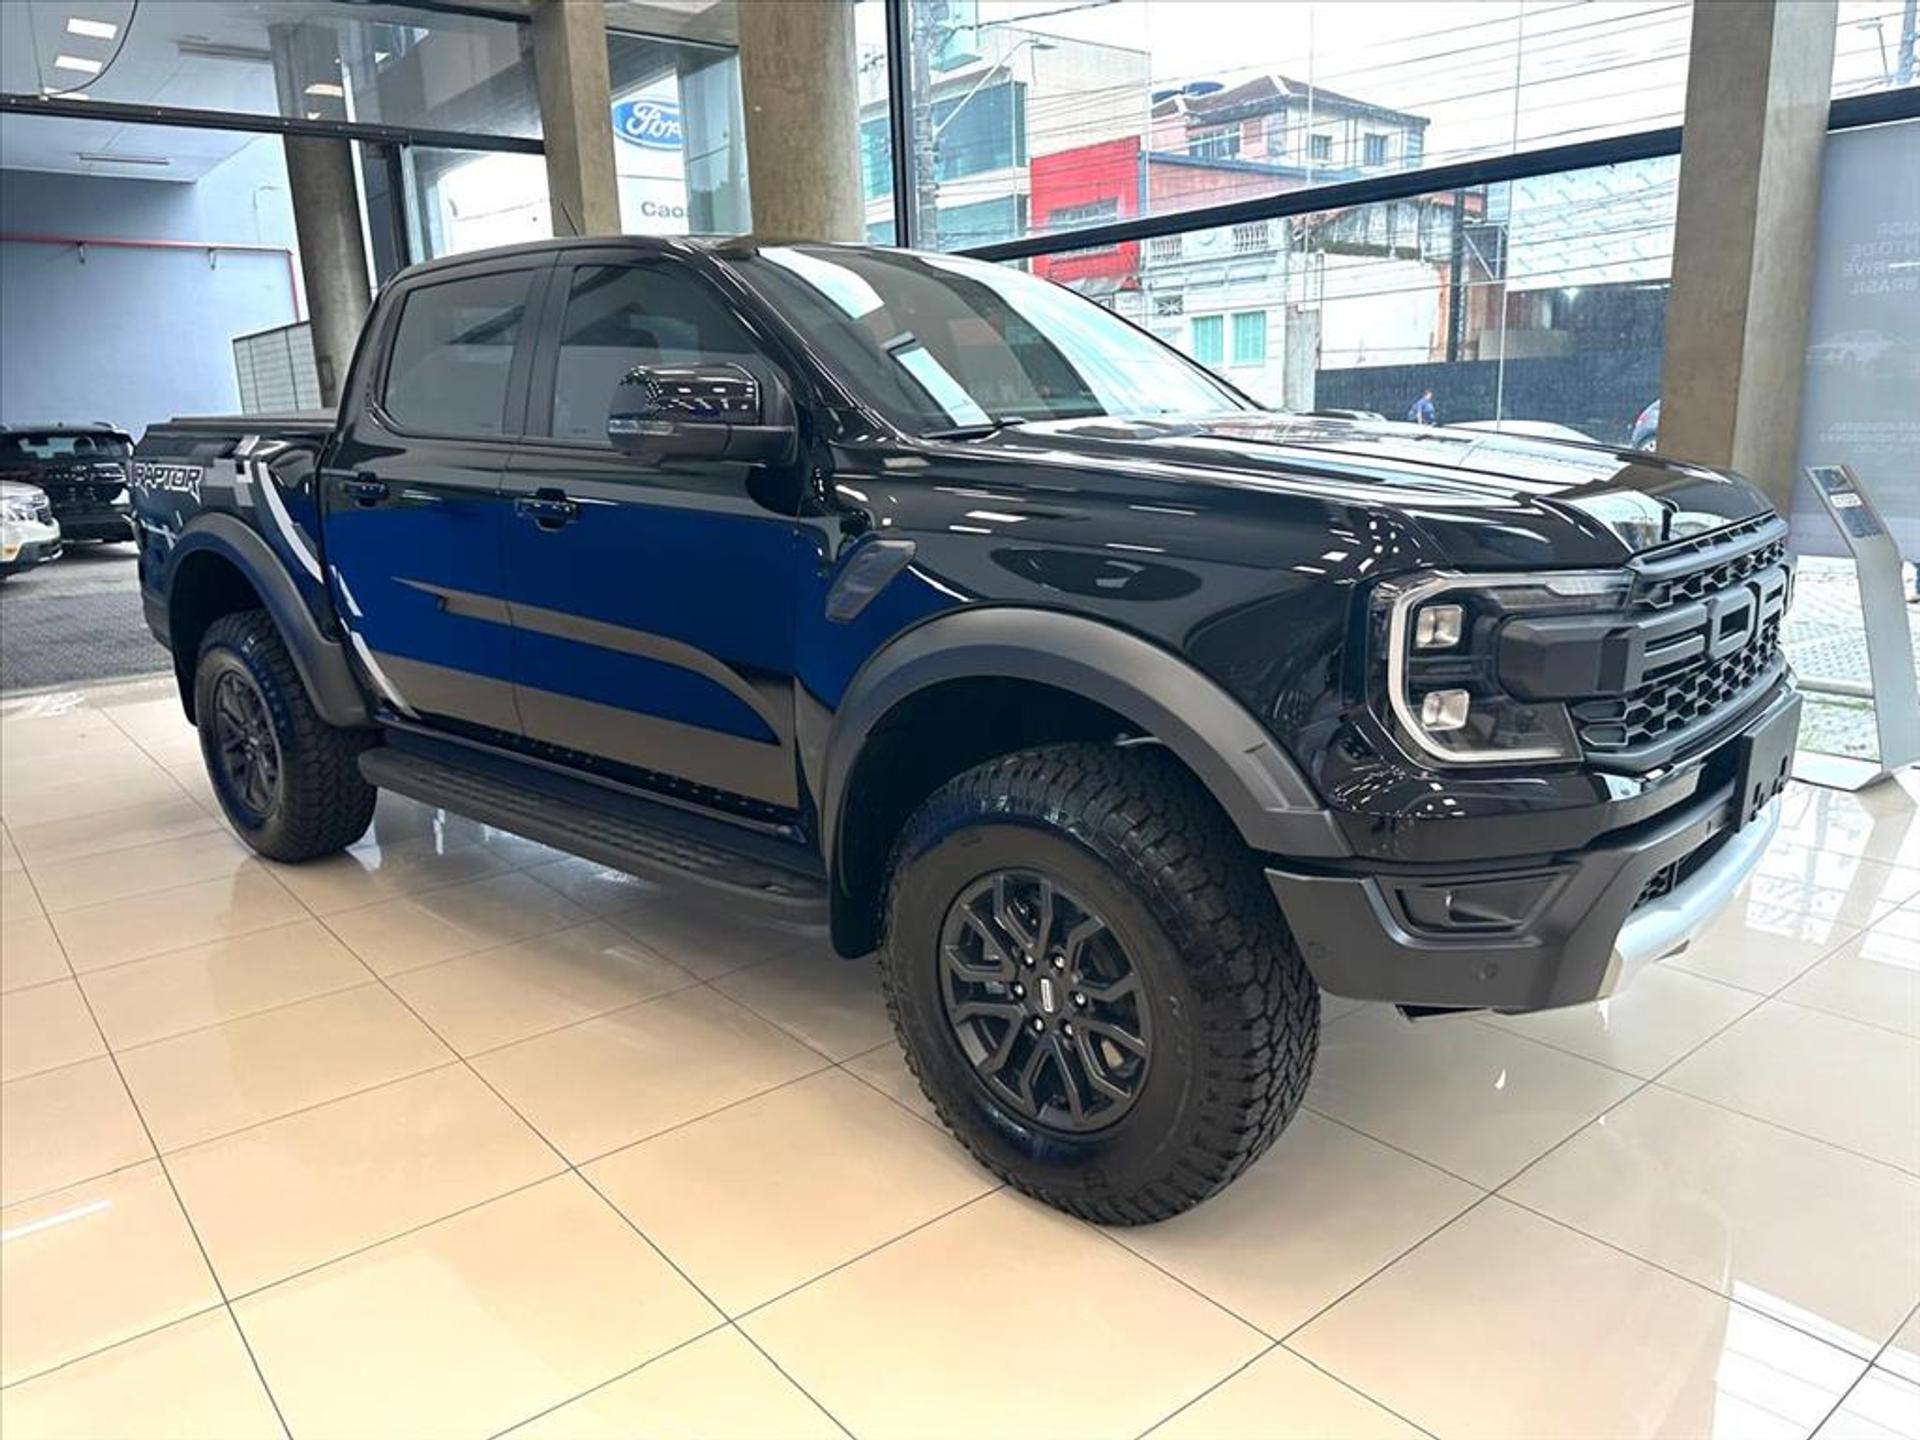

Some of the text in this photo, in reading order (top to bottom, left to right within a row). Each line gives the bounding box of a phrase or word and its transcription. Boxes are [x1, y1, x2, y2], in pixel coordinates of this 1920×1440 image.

[626, 102, 684, 138] For
[641, 201, 687, 219] Cao
[128, 463, 203, 505] RAPTOR
[1624, 562, 1790, 693] FOR
